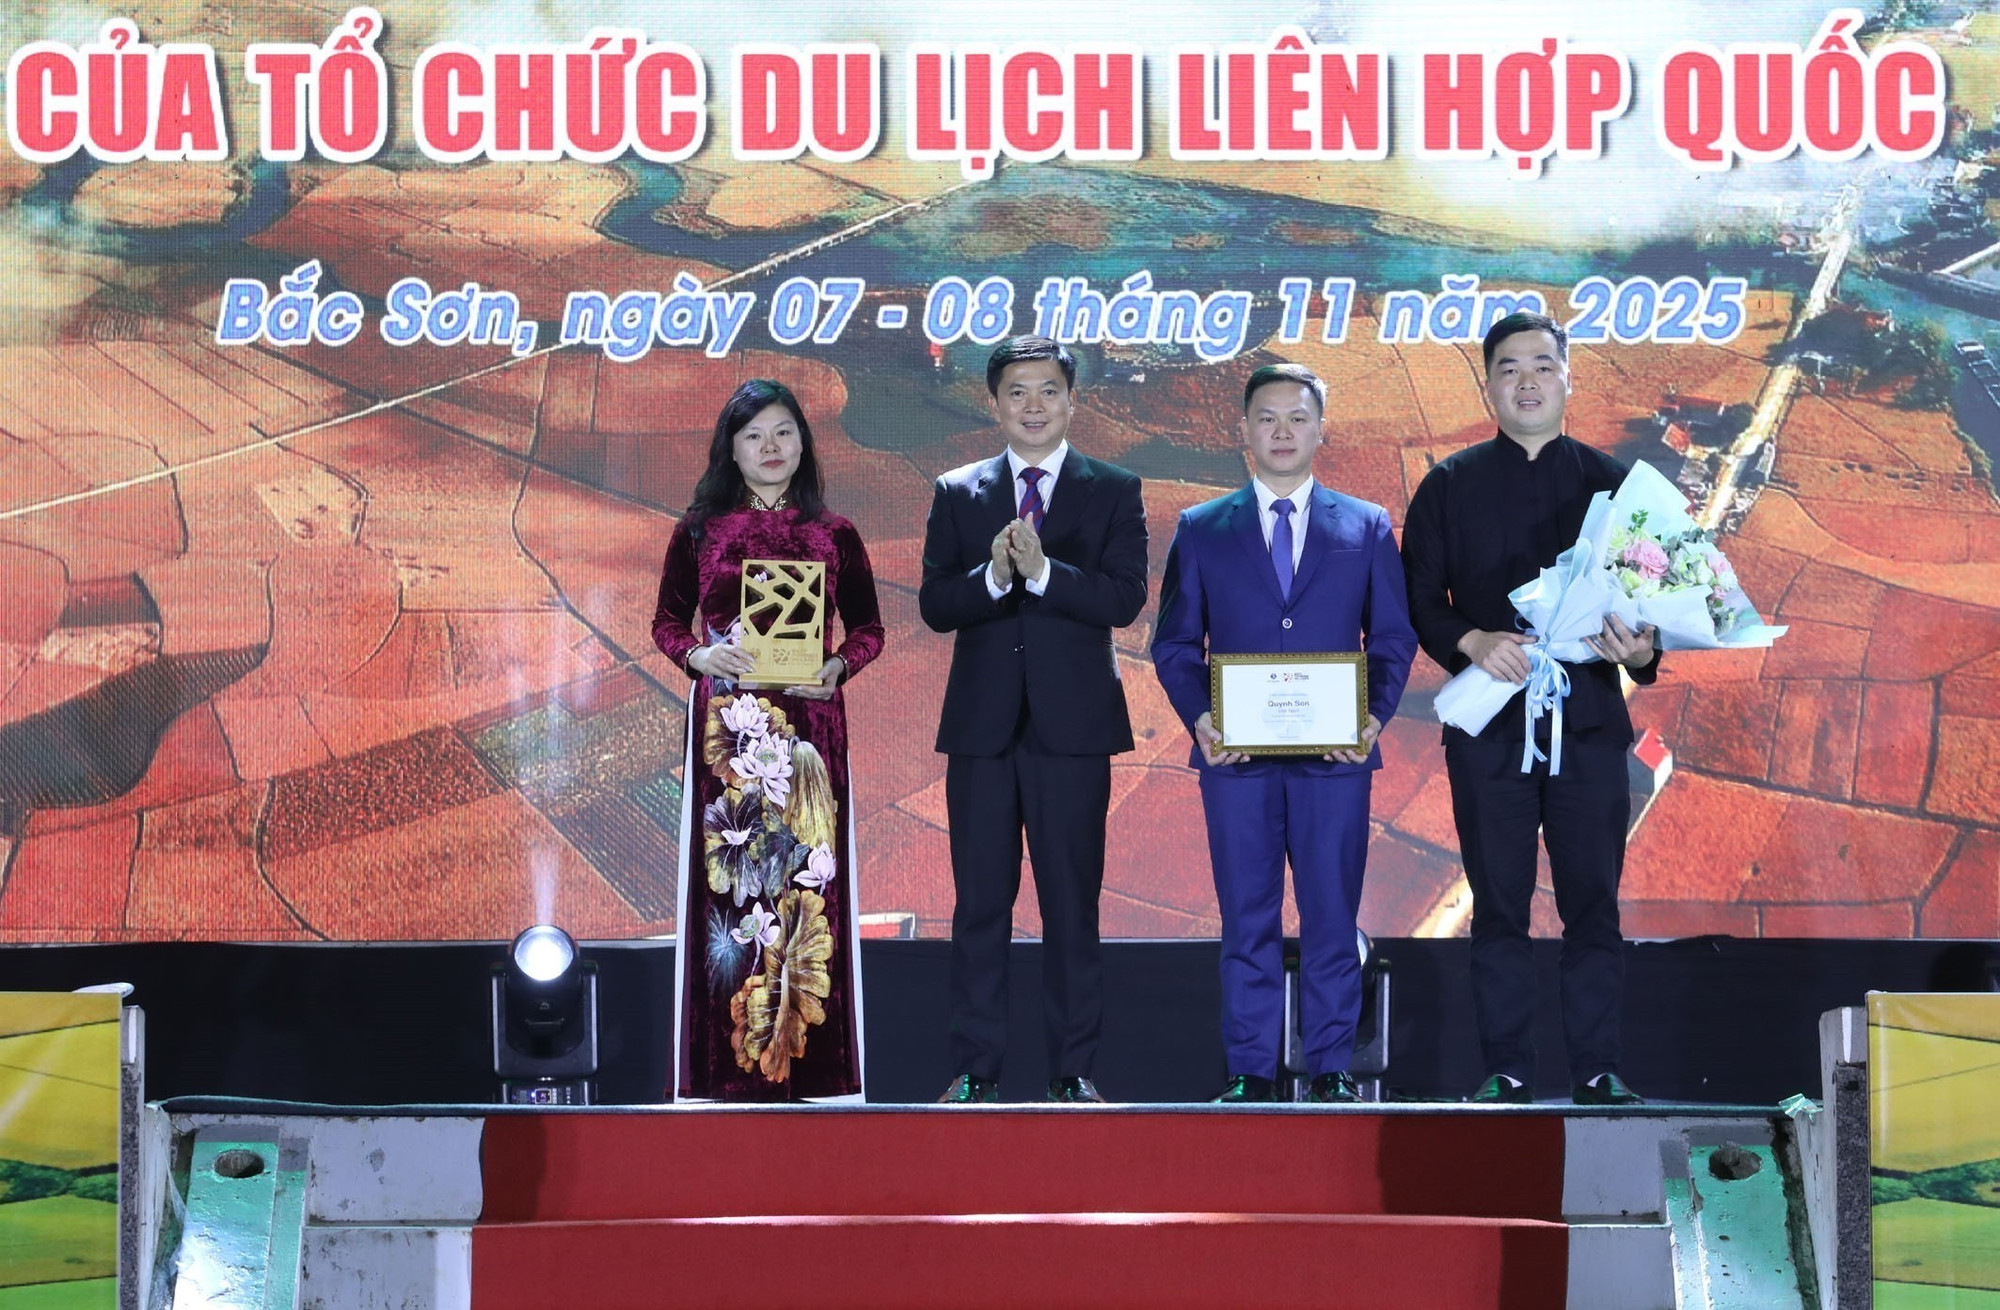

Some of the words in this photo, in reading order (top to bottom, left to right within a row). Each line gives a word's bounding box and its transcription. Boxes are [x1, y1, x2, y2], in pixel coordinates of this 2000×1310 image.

[14, 26, 221, 154] CỦA
[253, 15, 382, 154] TỔ
[420, 35, 700, 154] CHỨC
[738, 51, 874, 154] DU
[913, 50, 1136, 172] LỊCH
[1176, 33, 1381, 152] LIÊN
[1420, 35, 1623, 172] HỢP
[1661, 16, 1939, 164] QUỐC
[218, 263, 363, 343] Bắc
[383, 280, 535, 352] Sơn,
[561, 275, 752, 358] ngày
[770, 279, 862, 342] 07
[880, 307, 907, 326] -
[926, 279, 1011, 342] 08
[1036, 274, 1250, 359] tháng
[1278, 278, 1356, 342] 11
[1564, 278, 1745, 343] 2025
